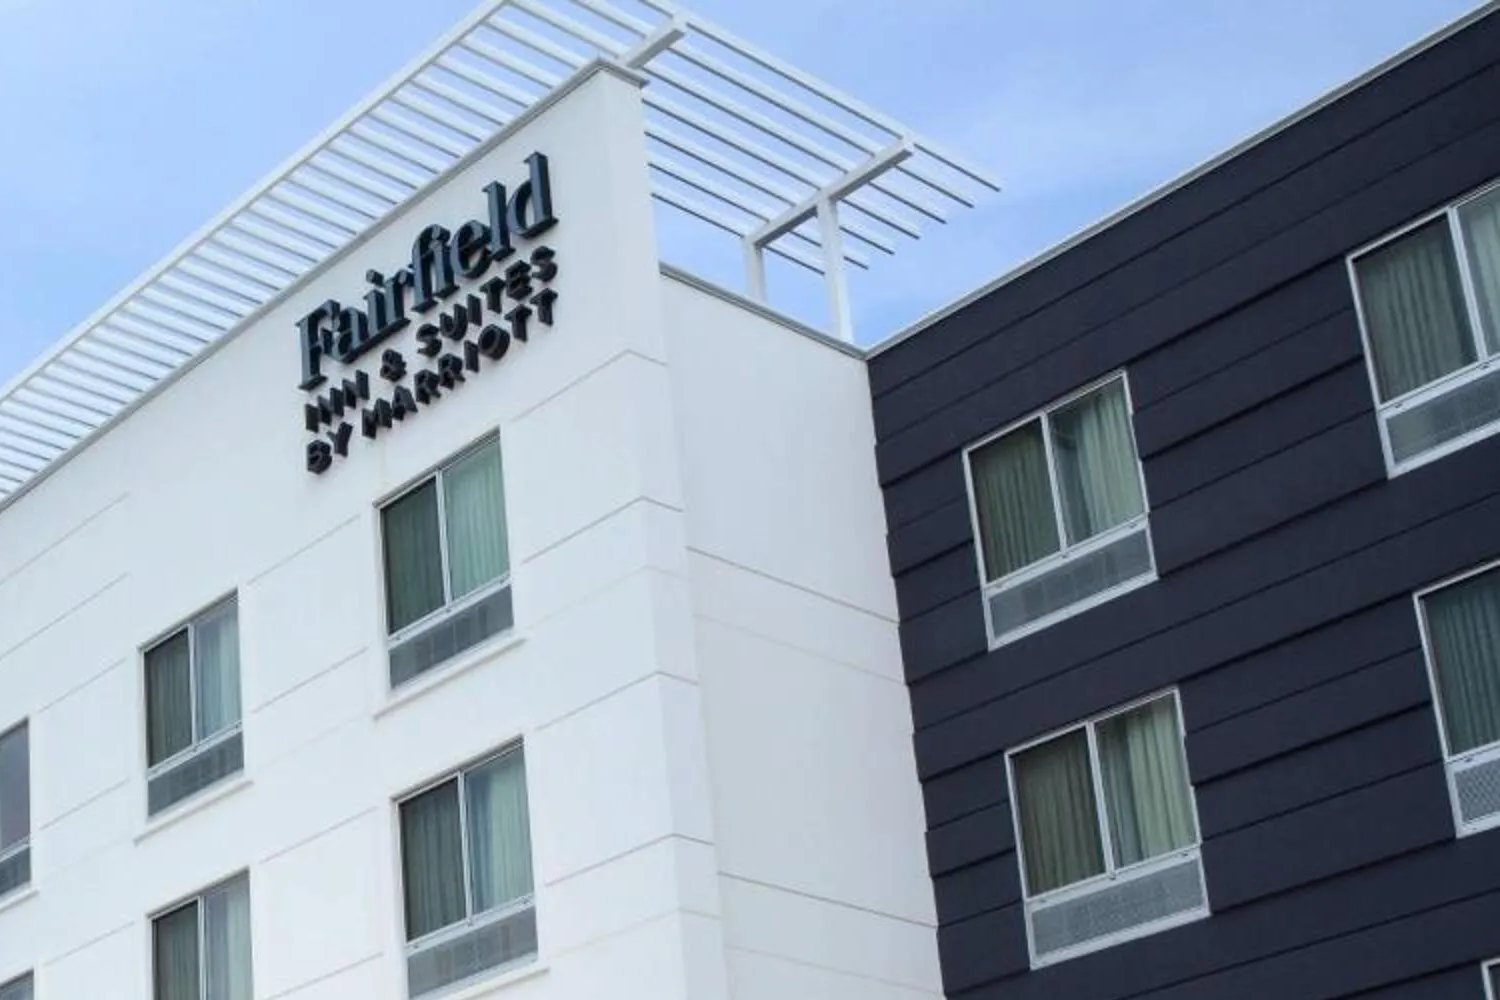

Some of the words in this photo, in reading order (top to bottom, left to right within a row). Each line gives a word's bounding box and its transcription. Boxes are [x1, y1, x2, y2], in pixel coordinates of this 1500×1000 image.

[295, 151, 559, 391] Fairfield
[304, 369, 370, 433] INN
[380, 348, 407, 382] &
[416, 246, 558, 358] SUITES
[306, 421, 353, 475] BY
[361, 287, 558, 439] MARRIOTT
